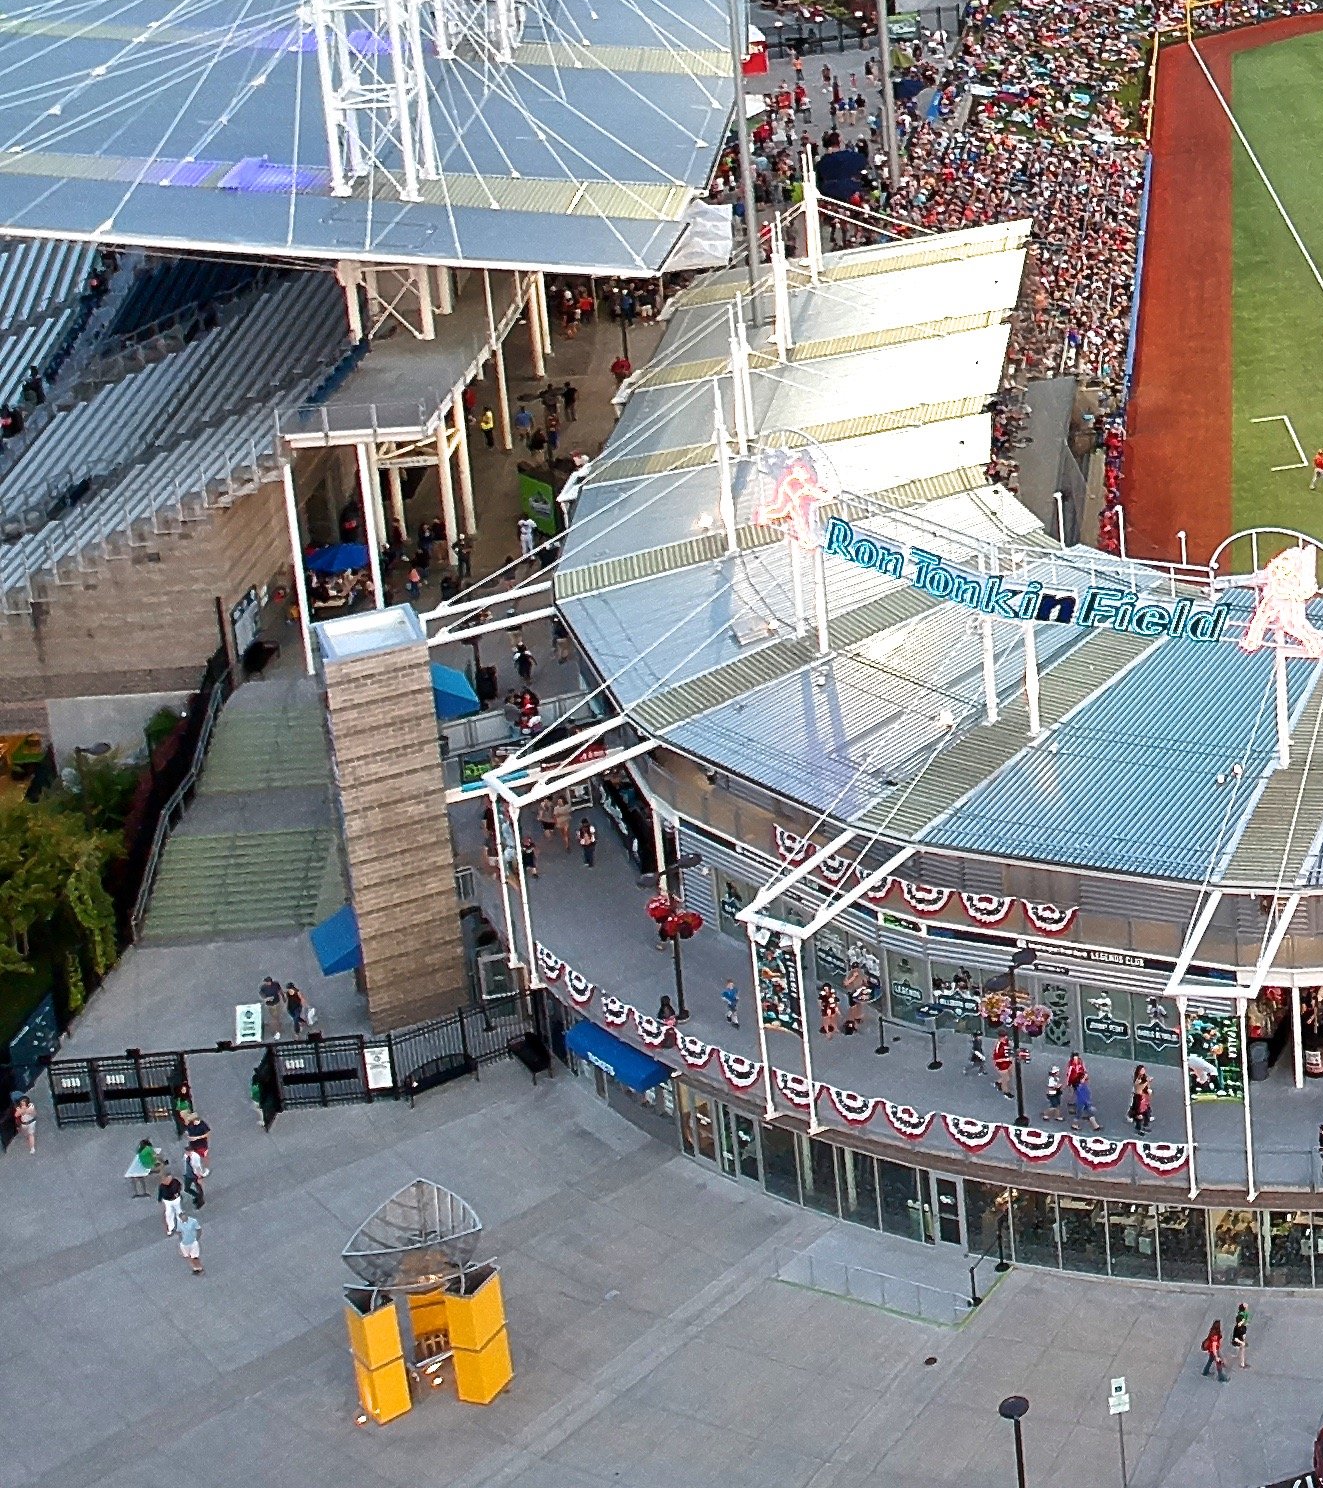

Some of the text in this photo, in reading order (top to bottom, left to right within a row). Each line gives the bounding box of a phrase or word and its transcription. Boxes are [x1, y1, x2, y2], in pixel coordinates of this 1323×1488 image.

[824, 516, 1232, 644] Ron Tonkin Field
